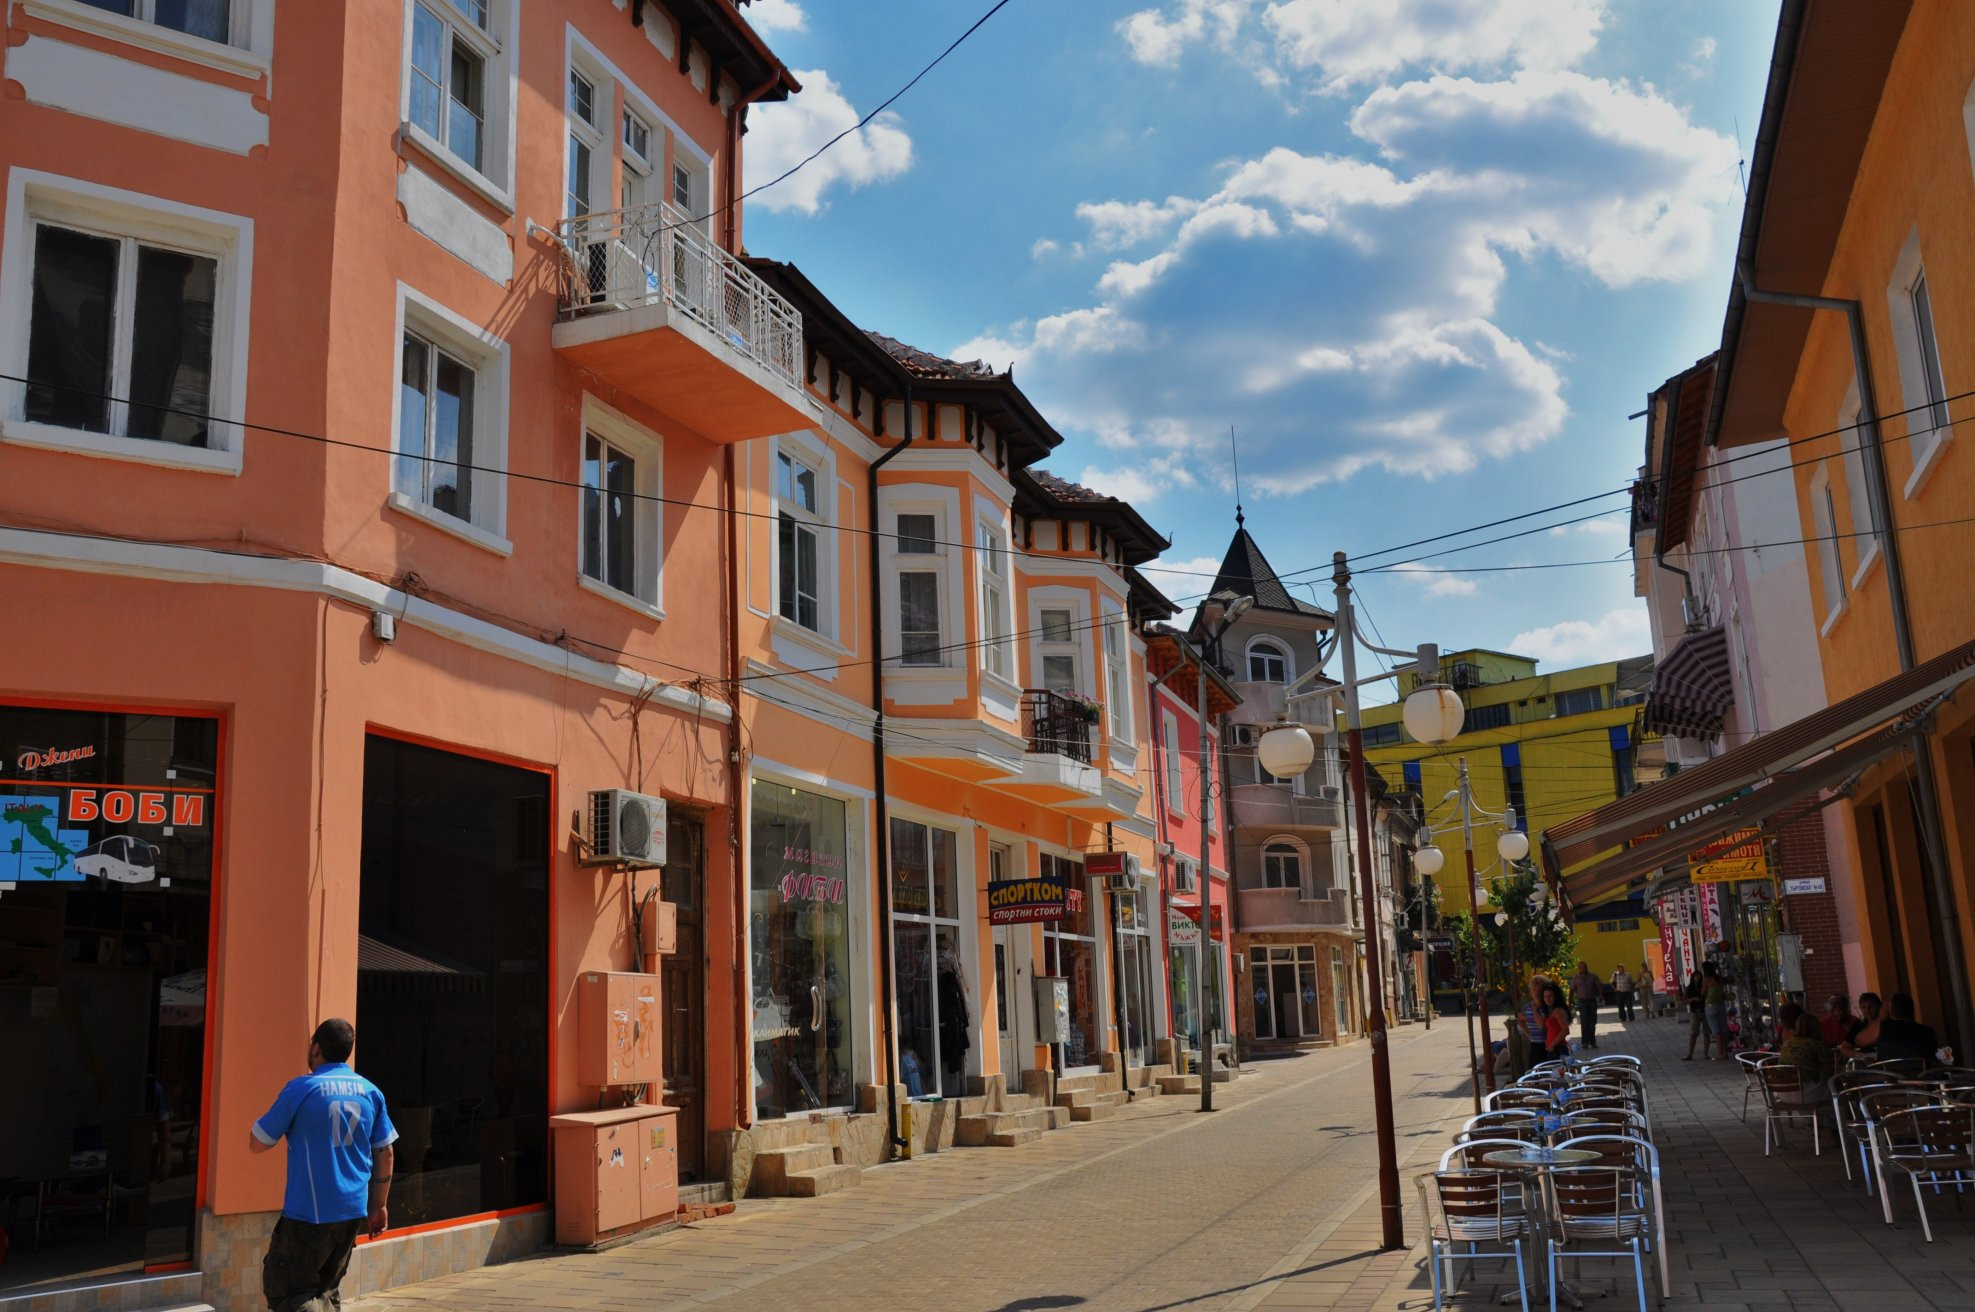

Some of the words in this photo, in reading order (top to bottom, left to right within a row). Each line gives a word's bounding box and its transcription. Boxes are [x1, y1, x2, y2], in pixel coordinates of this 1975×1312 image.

[18, 745, 96, 771] Джени
[68, 788, 204, 826] БОБИ
[781, 869, 844, 905] ФИБИ
[990, 881, 1063, 906] СПОРТКОМ
[993, 908, 1032, 921] спортни
[1034, 906, 1063, 918] стоки
[328, 1100, 362, 1147] 17
